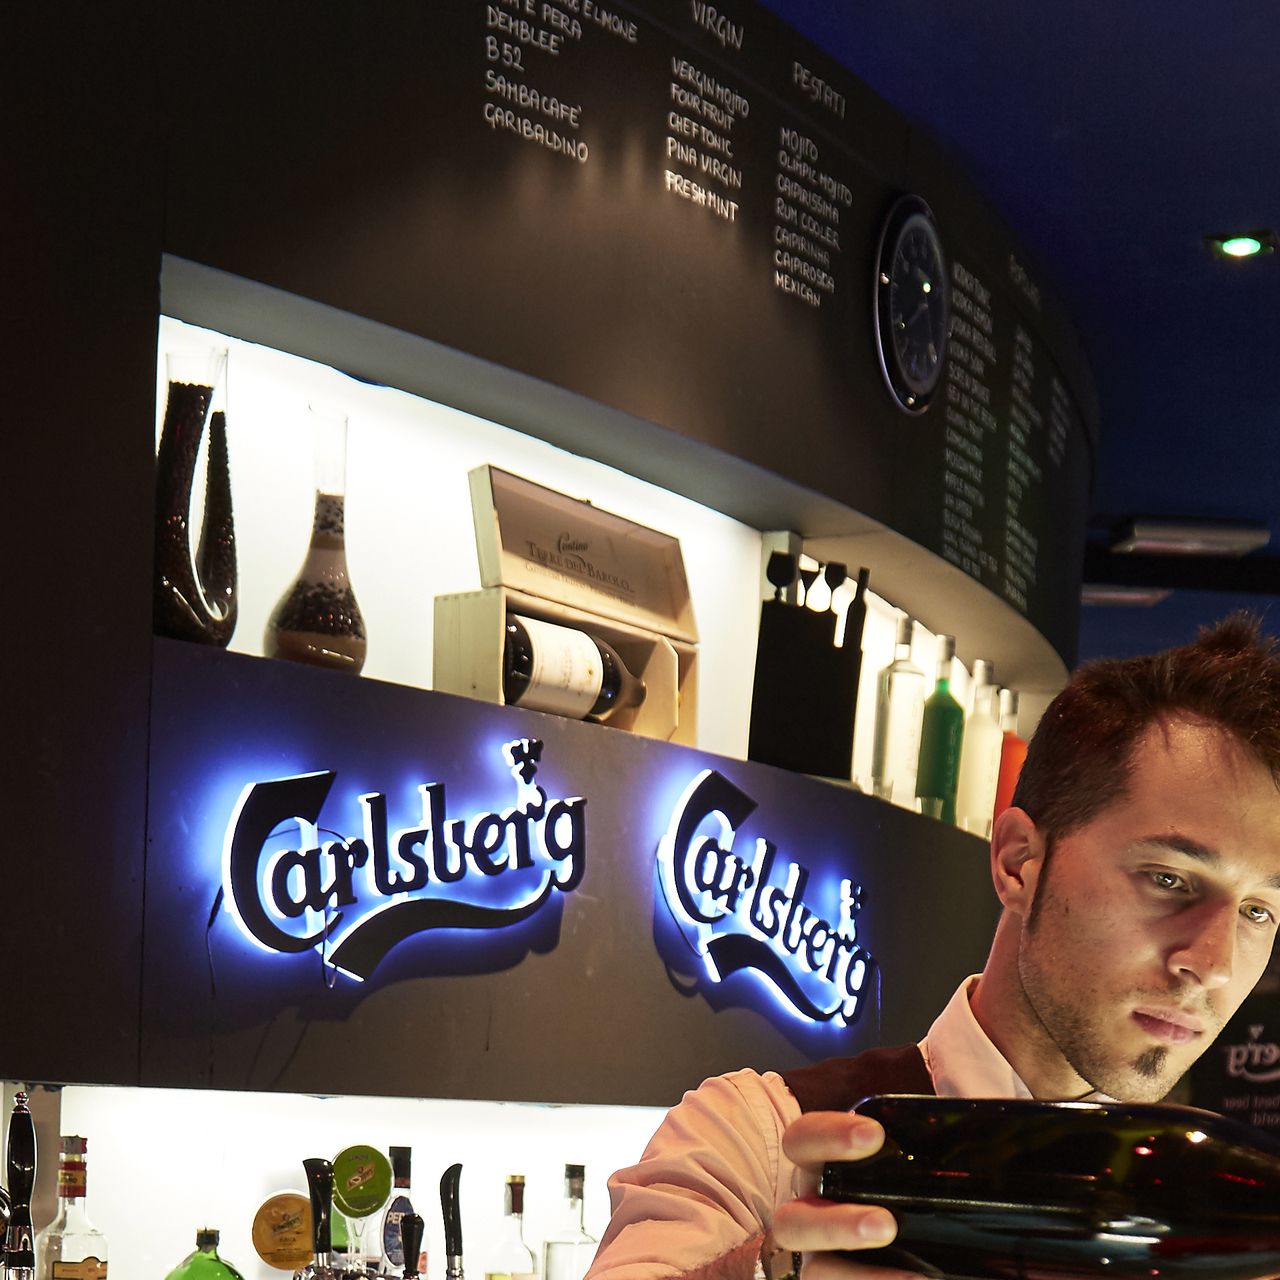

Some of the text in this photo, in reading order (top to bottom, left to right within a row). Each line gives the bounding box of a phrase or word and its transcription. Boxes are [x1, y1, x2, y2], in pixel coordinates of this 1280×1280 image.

[543, 2, 583, 40] PERA
[690, 0, 745, 51] VIRGIN
[670, 82, 701, 113] FOUR
[792, 60, 847, 121] PESTATI
[483, 102, 589, 163] GARIBALDINO
[781, 126, 819, 162] MOJITO
[666, 136, 743, 190] PINA VIRGIN
[819, 170, 854, 208] MOJITO
[664, 169, 740, 222] FRESH MINT
[775, 197, 841, 252] RUM COOLER
[775, 271, 822, 308] MEXICAN
[223, 741, 588, 962] Carlsberg
[660, 770, 878, 1022] Carlsberg
